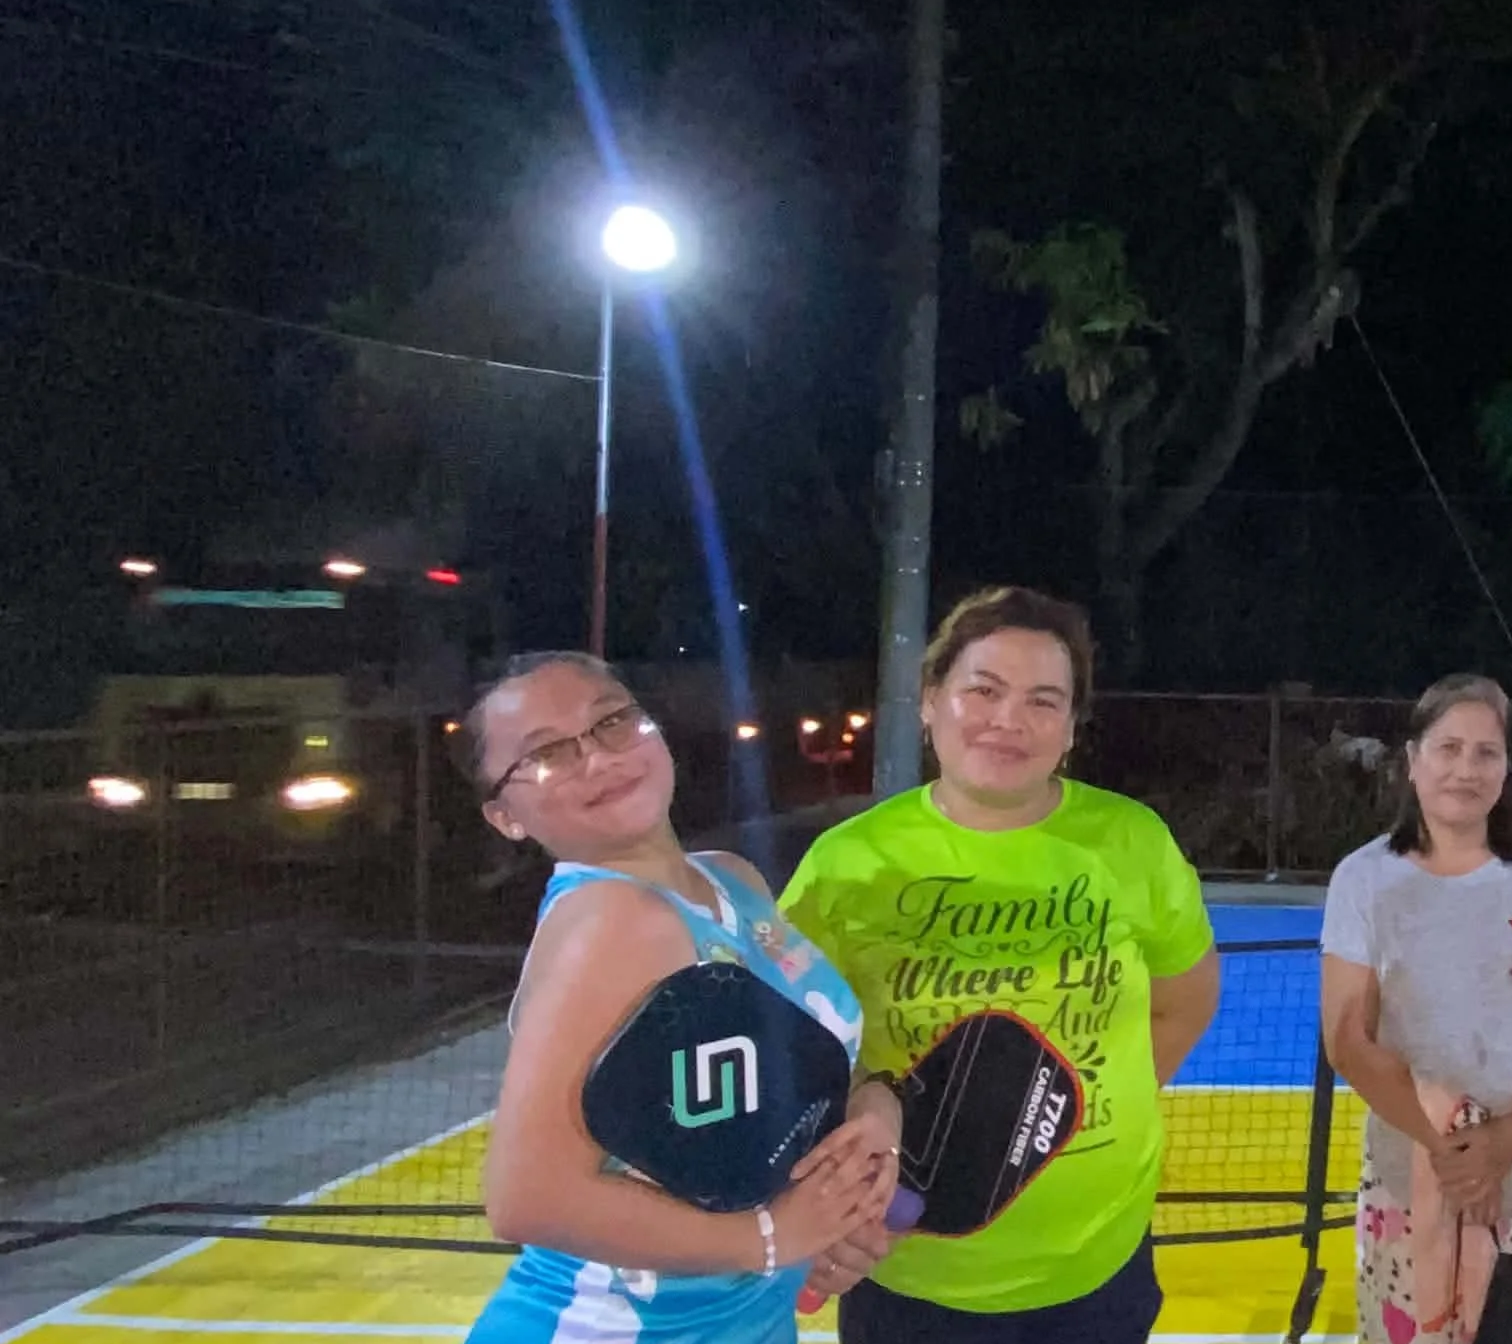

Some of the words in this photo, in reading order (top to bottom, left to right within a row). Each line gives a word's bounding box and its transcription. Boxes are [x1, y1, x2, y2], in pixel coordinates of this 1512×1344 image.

[888, 873, 1111, 956] Family
[886, 955, 1037, 1002] Where
[1054, 944, 1122, 1005] Life
[1045, 993, 1119, 1041] And
[1024, 1066, 1051, 1125] CARBON
[1034, 1093, 1067, 1154] T700
[1009, 1125, 1032, 1167] FIBER
